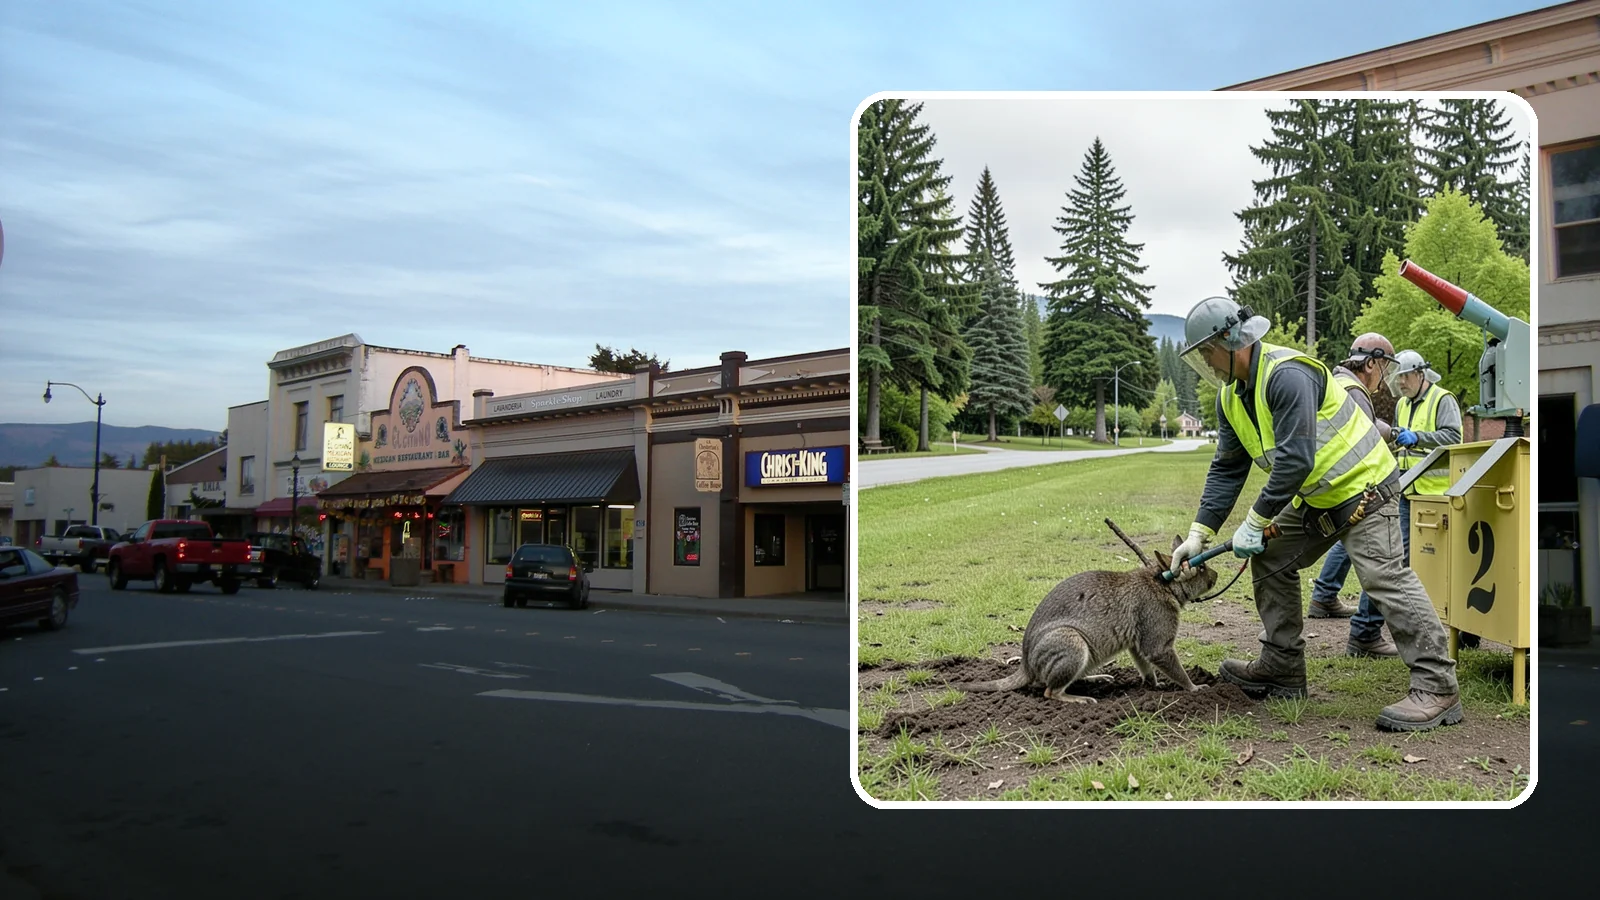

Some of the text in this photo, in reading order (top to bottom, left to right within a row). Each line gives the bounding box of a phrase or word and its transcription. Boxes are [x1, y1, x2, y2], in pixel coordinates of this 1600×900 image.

[562, 394, 582, 406] Shop
[595, 389, 624, 400] LAUNDRY
[493, 402, 522, 412] LAVANDERIA
[397, 451, 433, 463] RESTAURANT
[438, 450, 450, 459] BAR
[761, 450, 827, 478] CHRIST KING
[1466, 520, 1496, 614] 2
